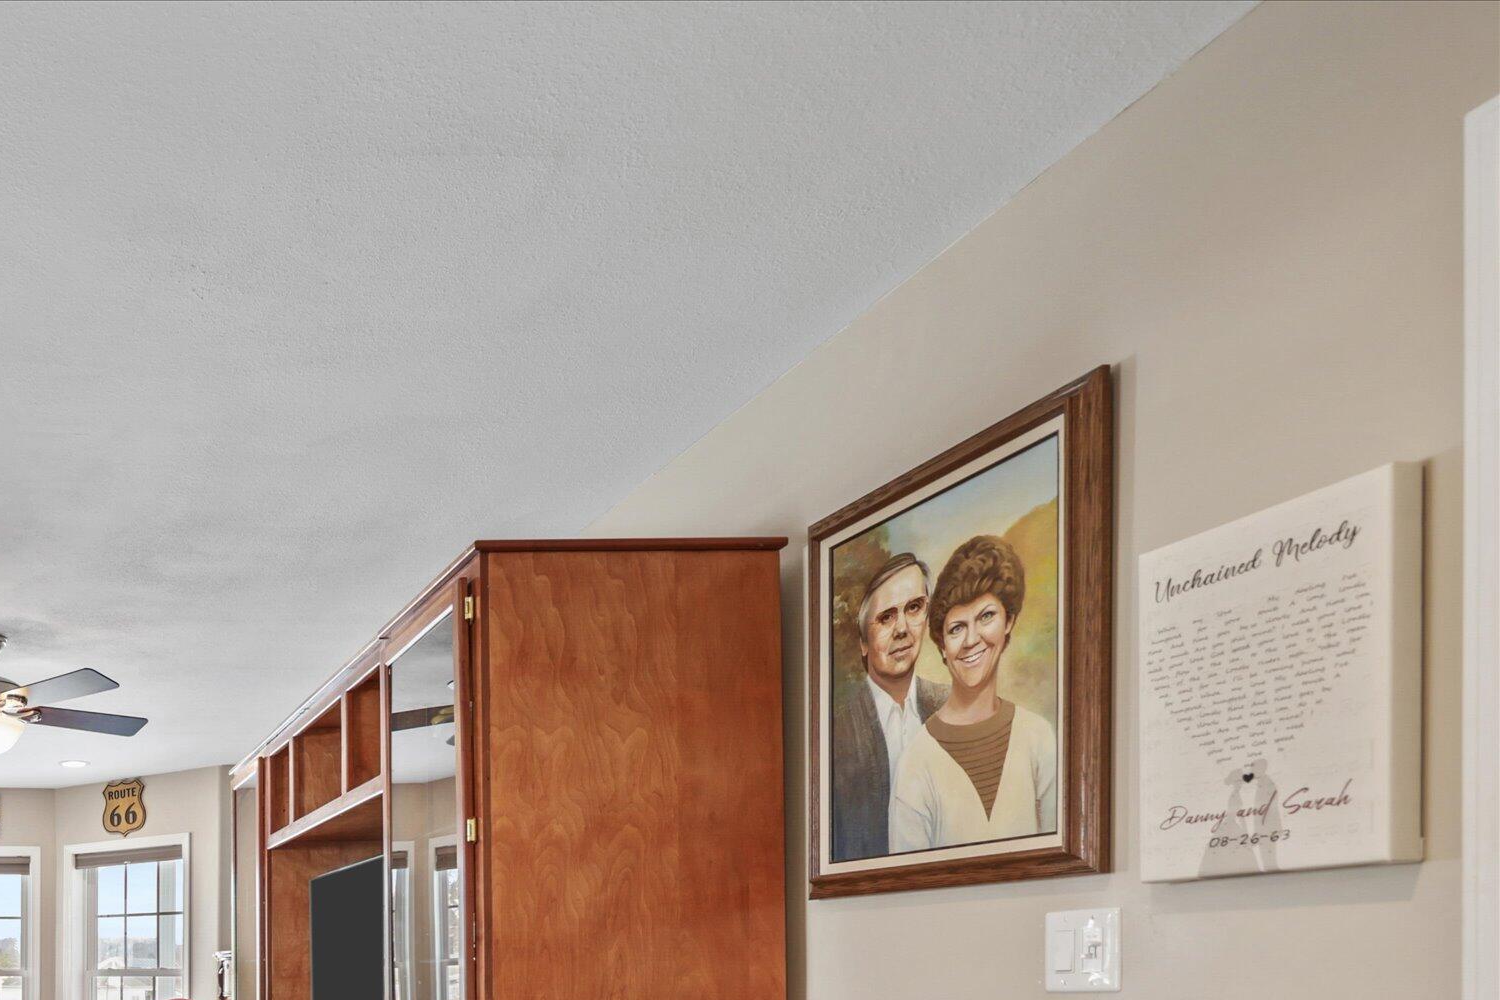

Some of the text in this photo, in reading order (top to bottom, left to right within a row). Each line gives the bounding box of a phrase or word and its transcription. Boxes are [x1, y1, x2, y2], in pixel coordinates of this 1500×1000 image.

[1154, 519, 1362, 604] Unchained Melody
[108, 787, 138, 801] ROUTE
[1159, 778, 1354, 833] Danny and Sarah
[109, 805, 138, 828] 66
[1208, 829, 1291, 849] 08-26-63
